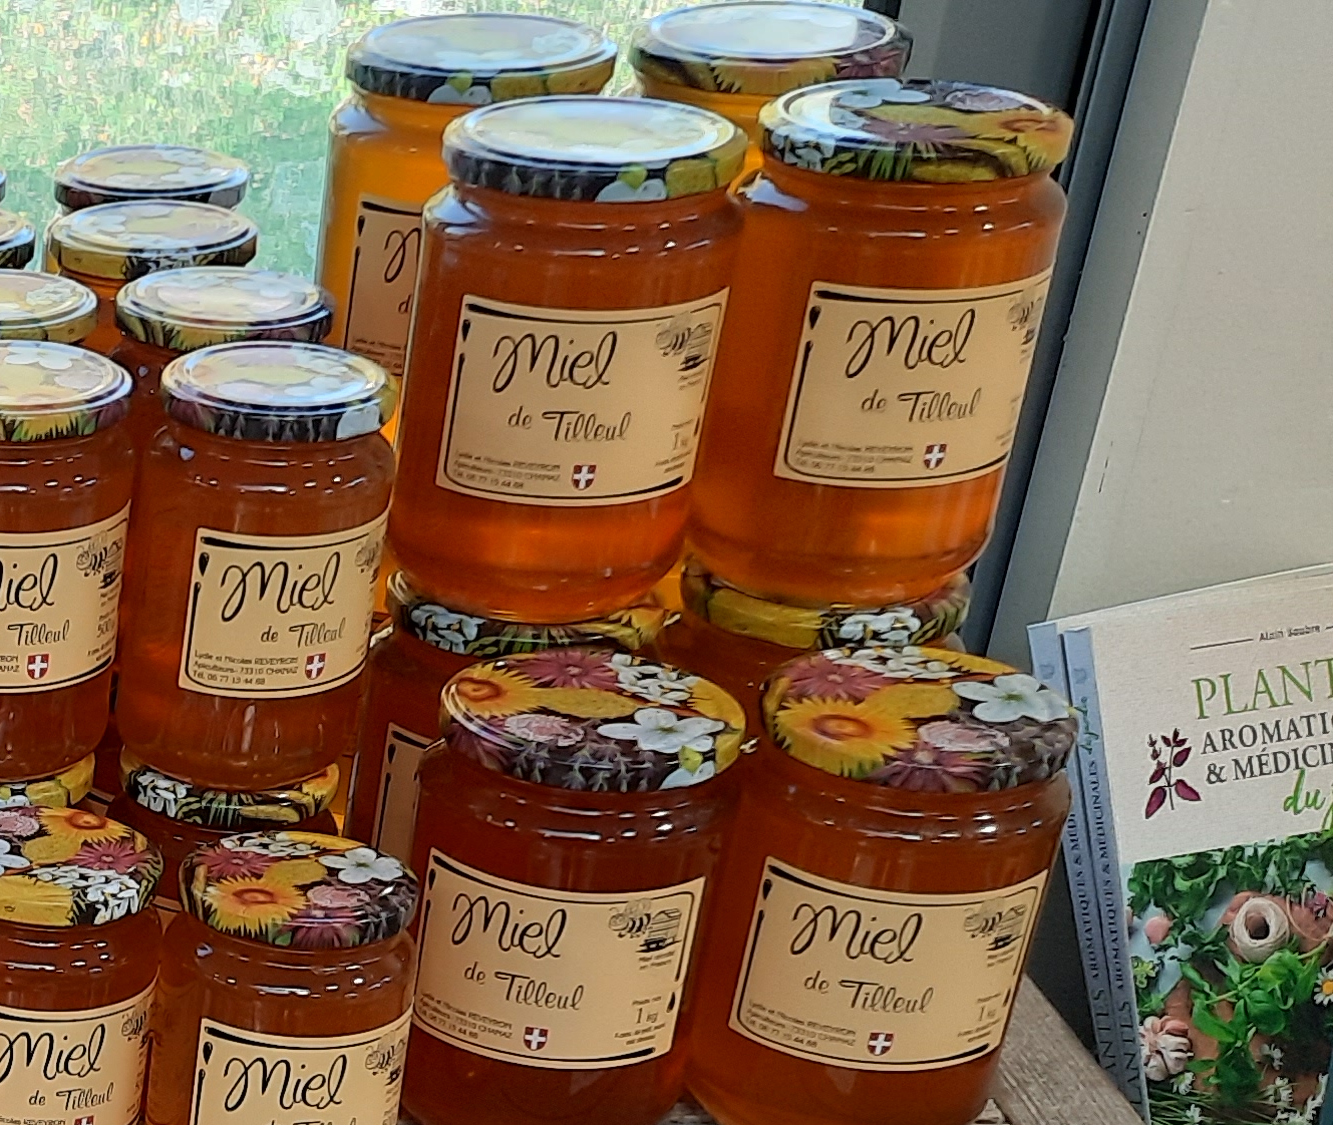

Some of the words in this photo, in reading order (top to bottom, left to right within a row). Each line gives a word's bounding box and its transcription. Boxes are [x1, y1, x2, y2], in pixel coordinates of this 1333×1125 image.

[492, 330, 618, 393] Miel
[844, 308, 976, 379] Miel
[507, 405, 532, 430] de
[541, 410, 632, 443] Tilleul
[897, 386, 982, 423] Tilleul
[220, 550, 341, 623] Miel
[6, 619, 70, 647] Tilleul
[260, 625, 279, 643] de
[1201, 712, 1333, 755] AROMATI
[1206, 761, 1228, 785] &
[1283, 767, 1327, 816] du
[451, 892, 567, 959] Miel
[790, 902, 923, 964] Miel
[1099, 880, 1125, 992] AROMATIQUES
[464, 960, 486, 985] de
[494, 970, 584, 1011] Tilleul
[804, 969, 830, 995] de
[837, 978, 935, 1014] Tilleul
[1091, 987, 1117, 1071] ANTES
[1117, 1000, 1143, 1109] LANTES
[28, 1089, 46, 1107] de
[55, 1081, 114, 1111] Tilleul
[223, 1054, 347, 1112] Miel
